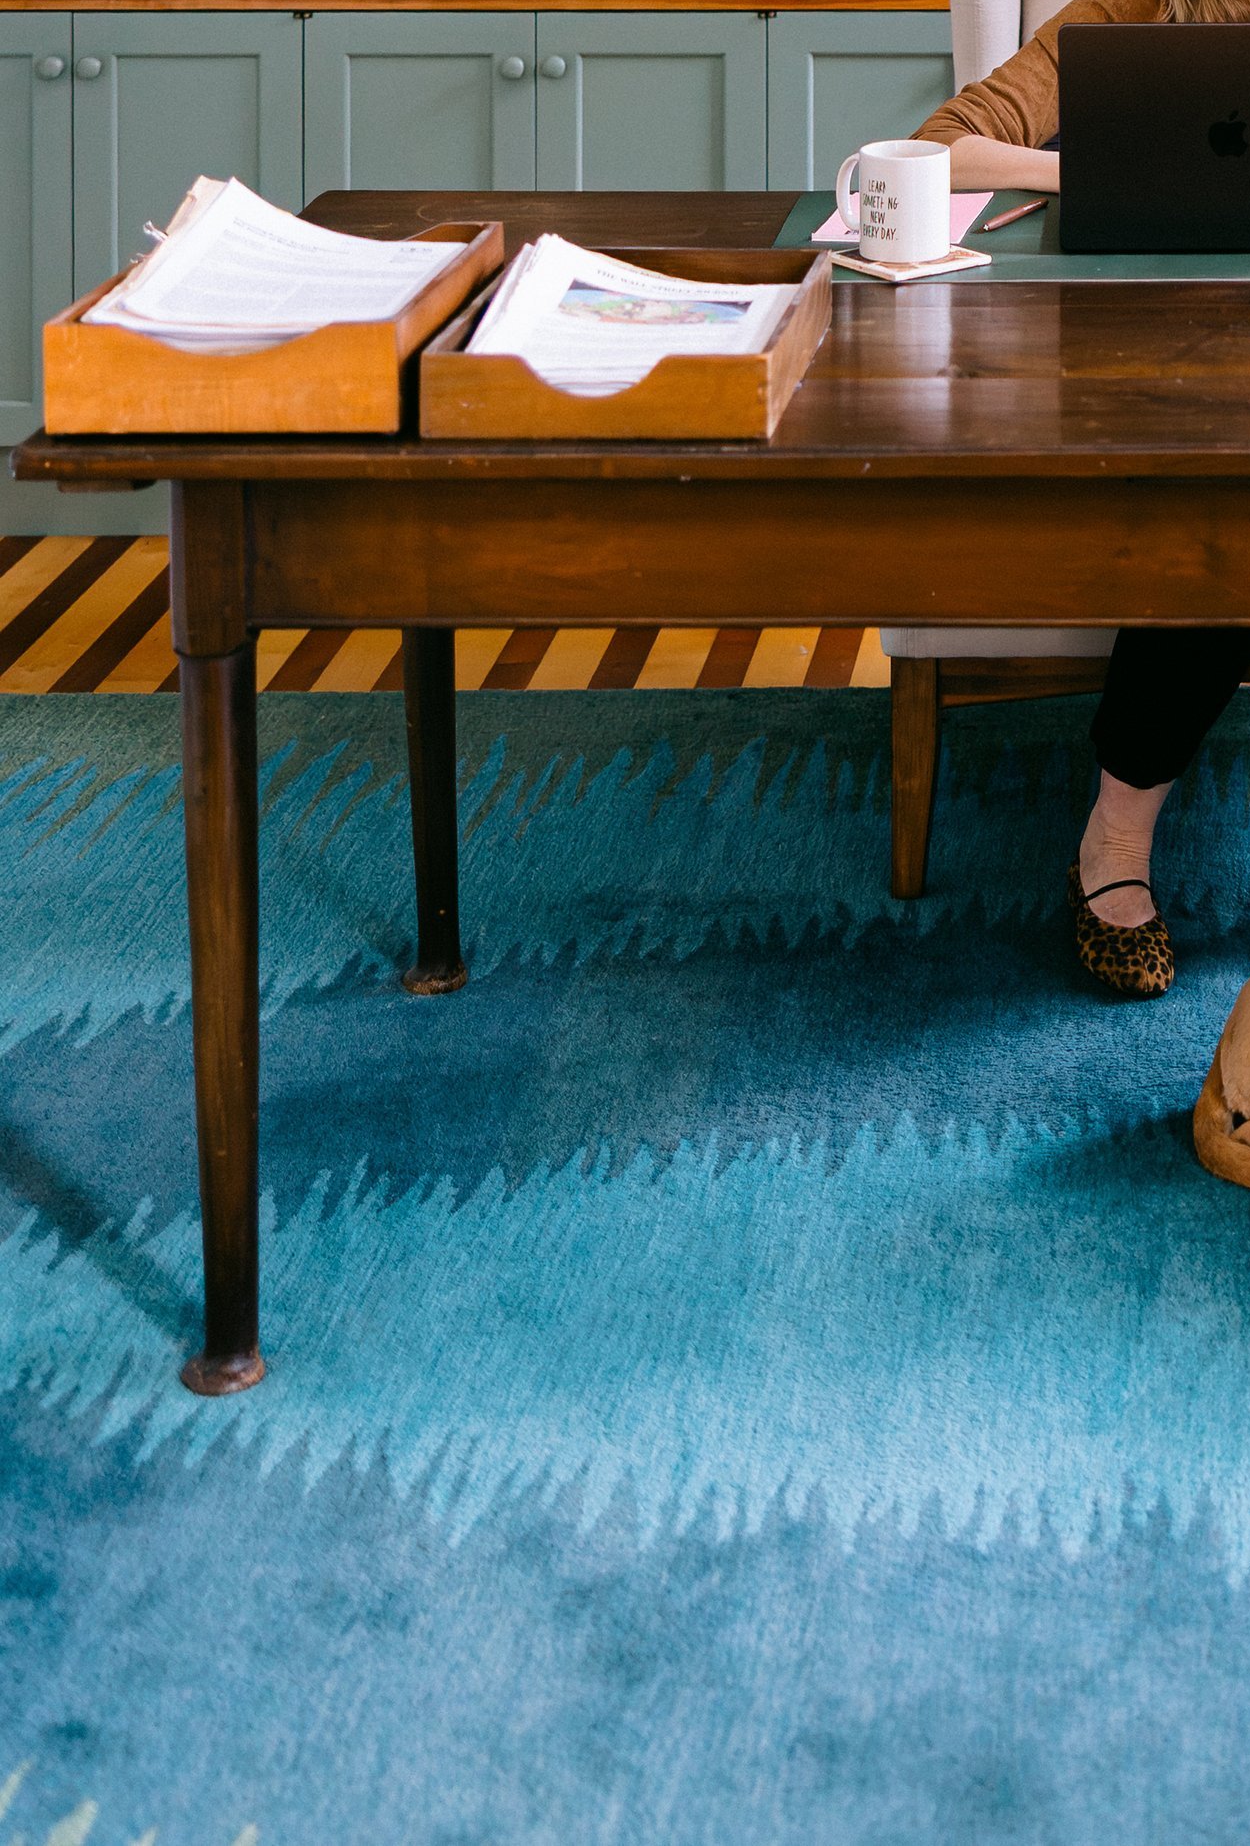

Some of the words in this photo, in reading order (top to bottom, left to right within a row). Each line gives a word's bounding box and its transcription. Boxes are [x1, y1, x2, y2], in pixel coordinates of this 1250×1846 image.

[870, 211, 886, 224] NEW
[863, 224, 880, 239] EVERY
[881, 228, 898, 240] DAY.
[621, 276, 647, 287] WALL
[652, 285, 692, 294] STREET
